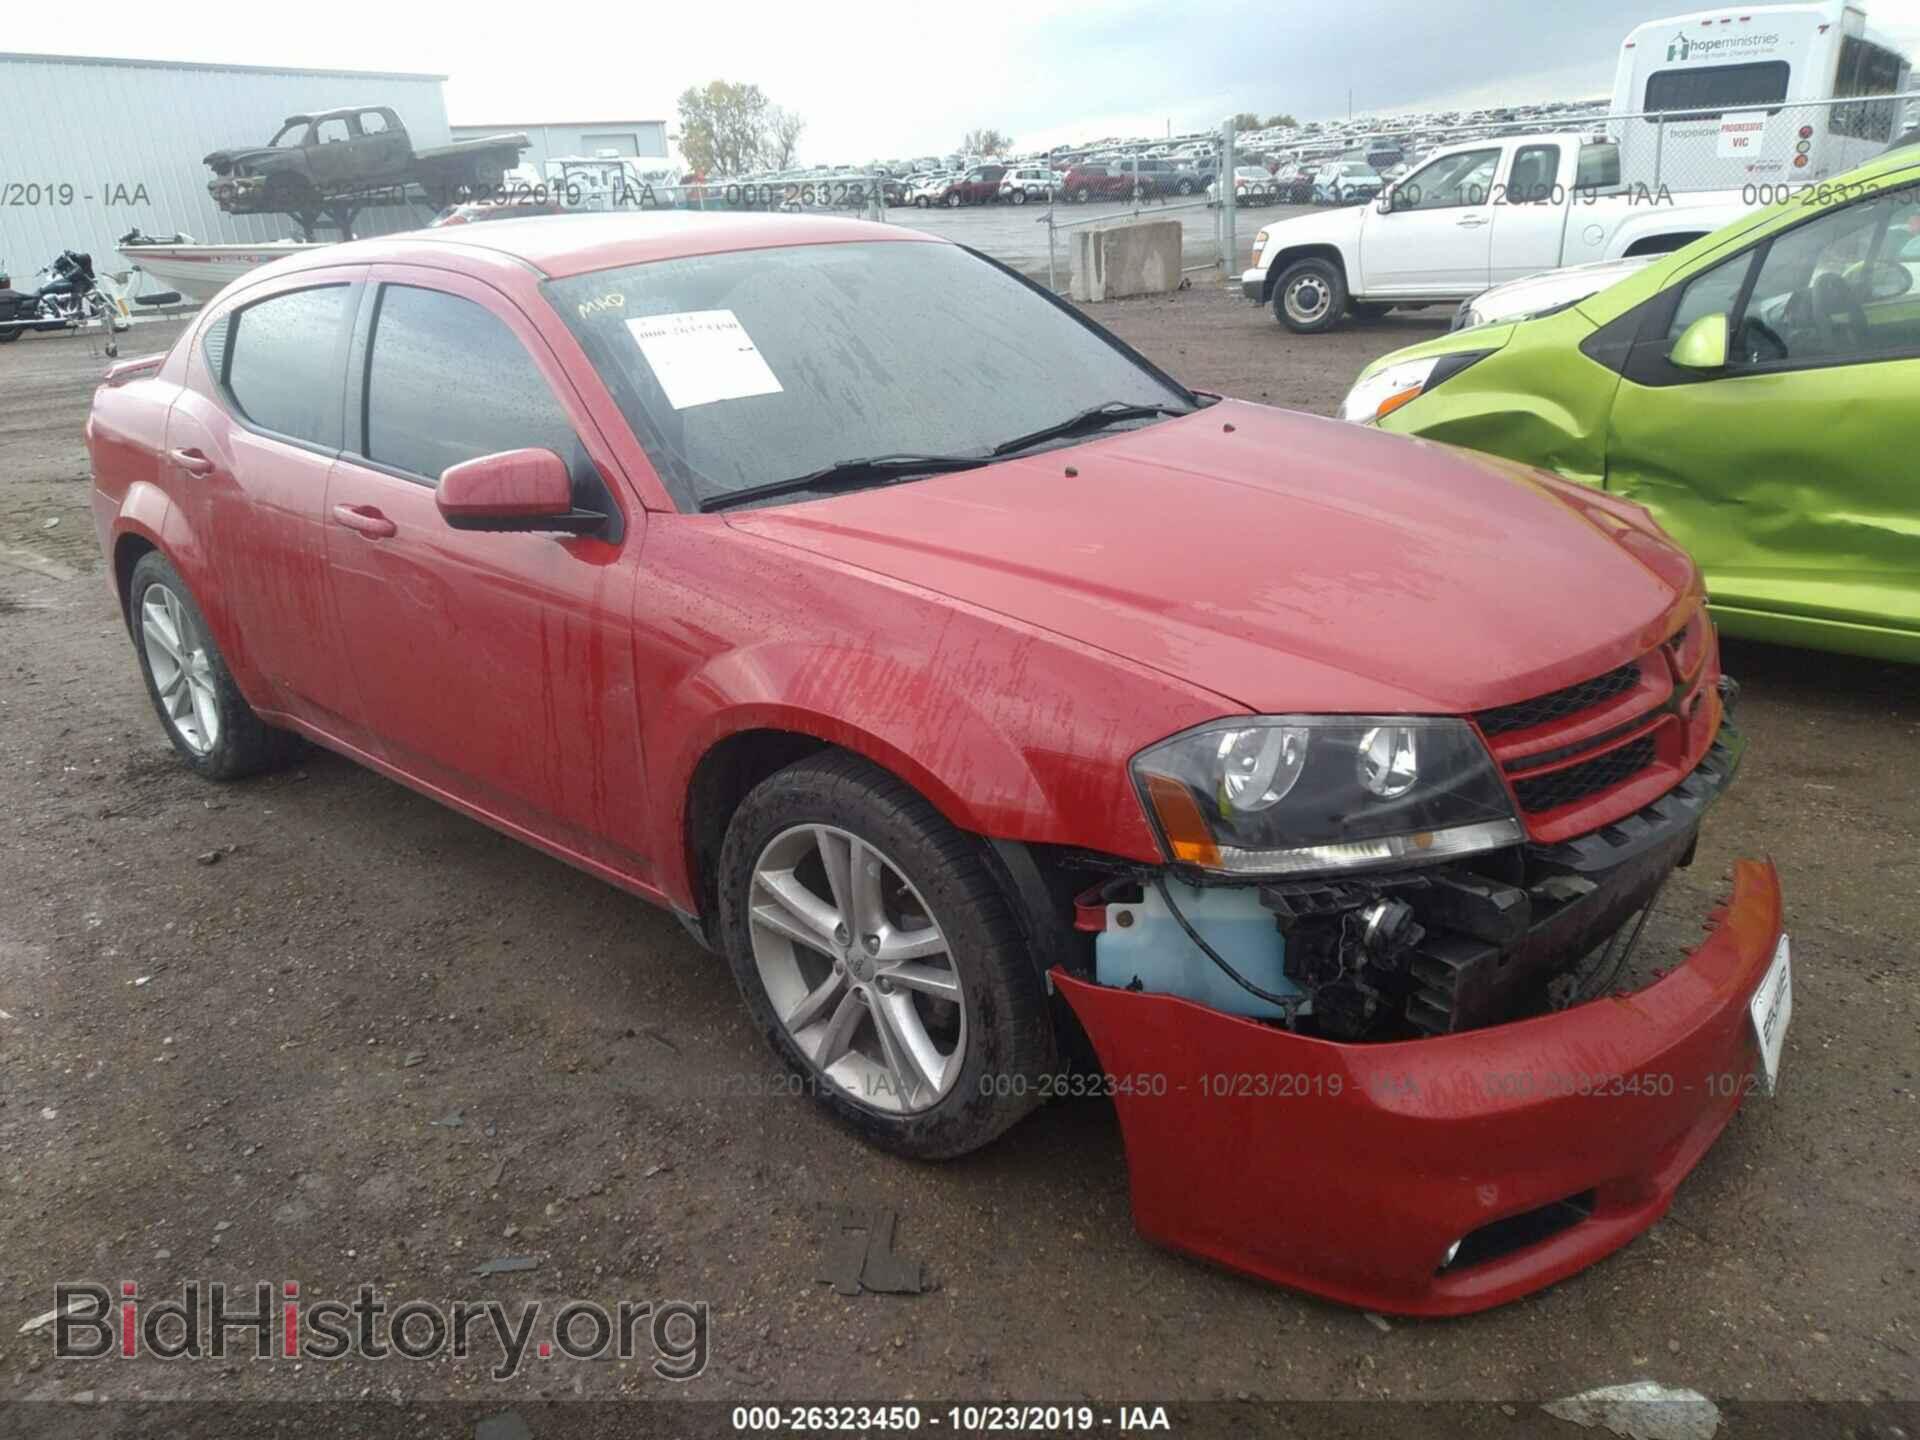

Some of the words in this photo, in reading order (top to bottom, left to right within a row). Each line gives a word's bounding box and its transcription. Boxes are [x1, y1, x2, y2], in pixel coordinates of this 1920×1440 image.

[1690, 33, 1779, 52] hopeministries
[1670, 127, 1719, 138] hopeiow
[1721, 122, 1763, 132] PROGRESSIVE
[1732, 137, 1749, 148] VIC
